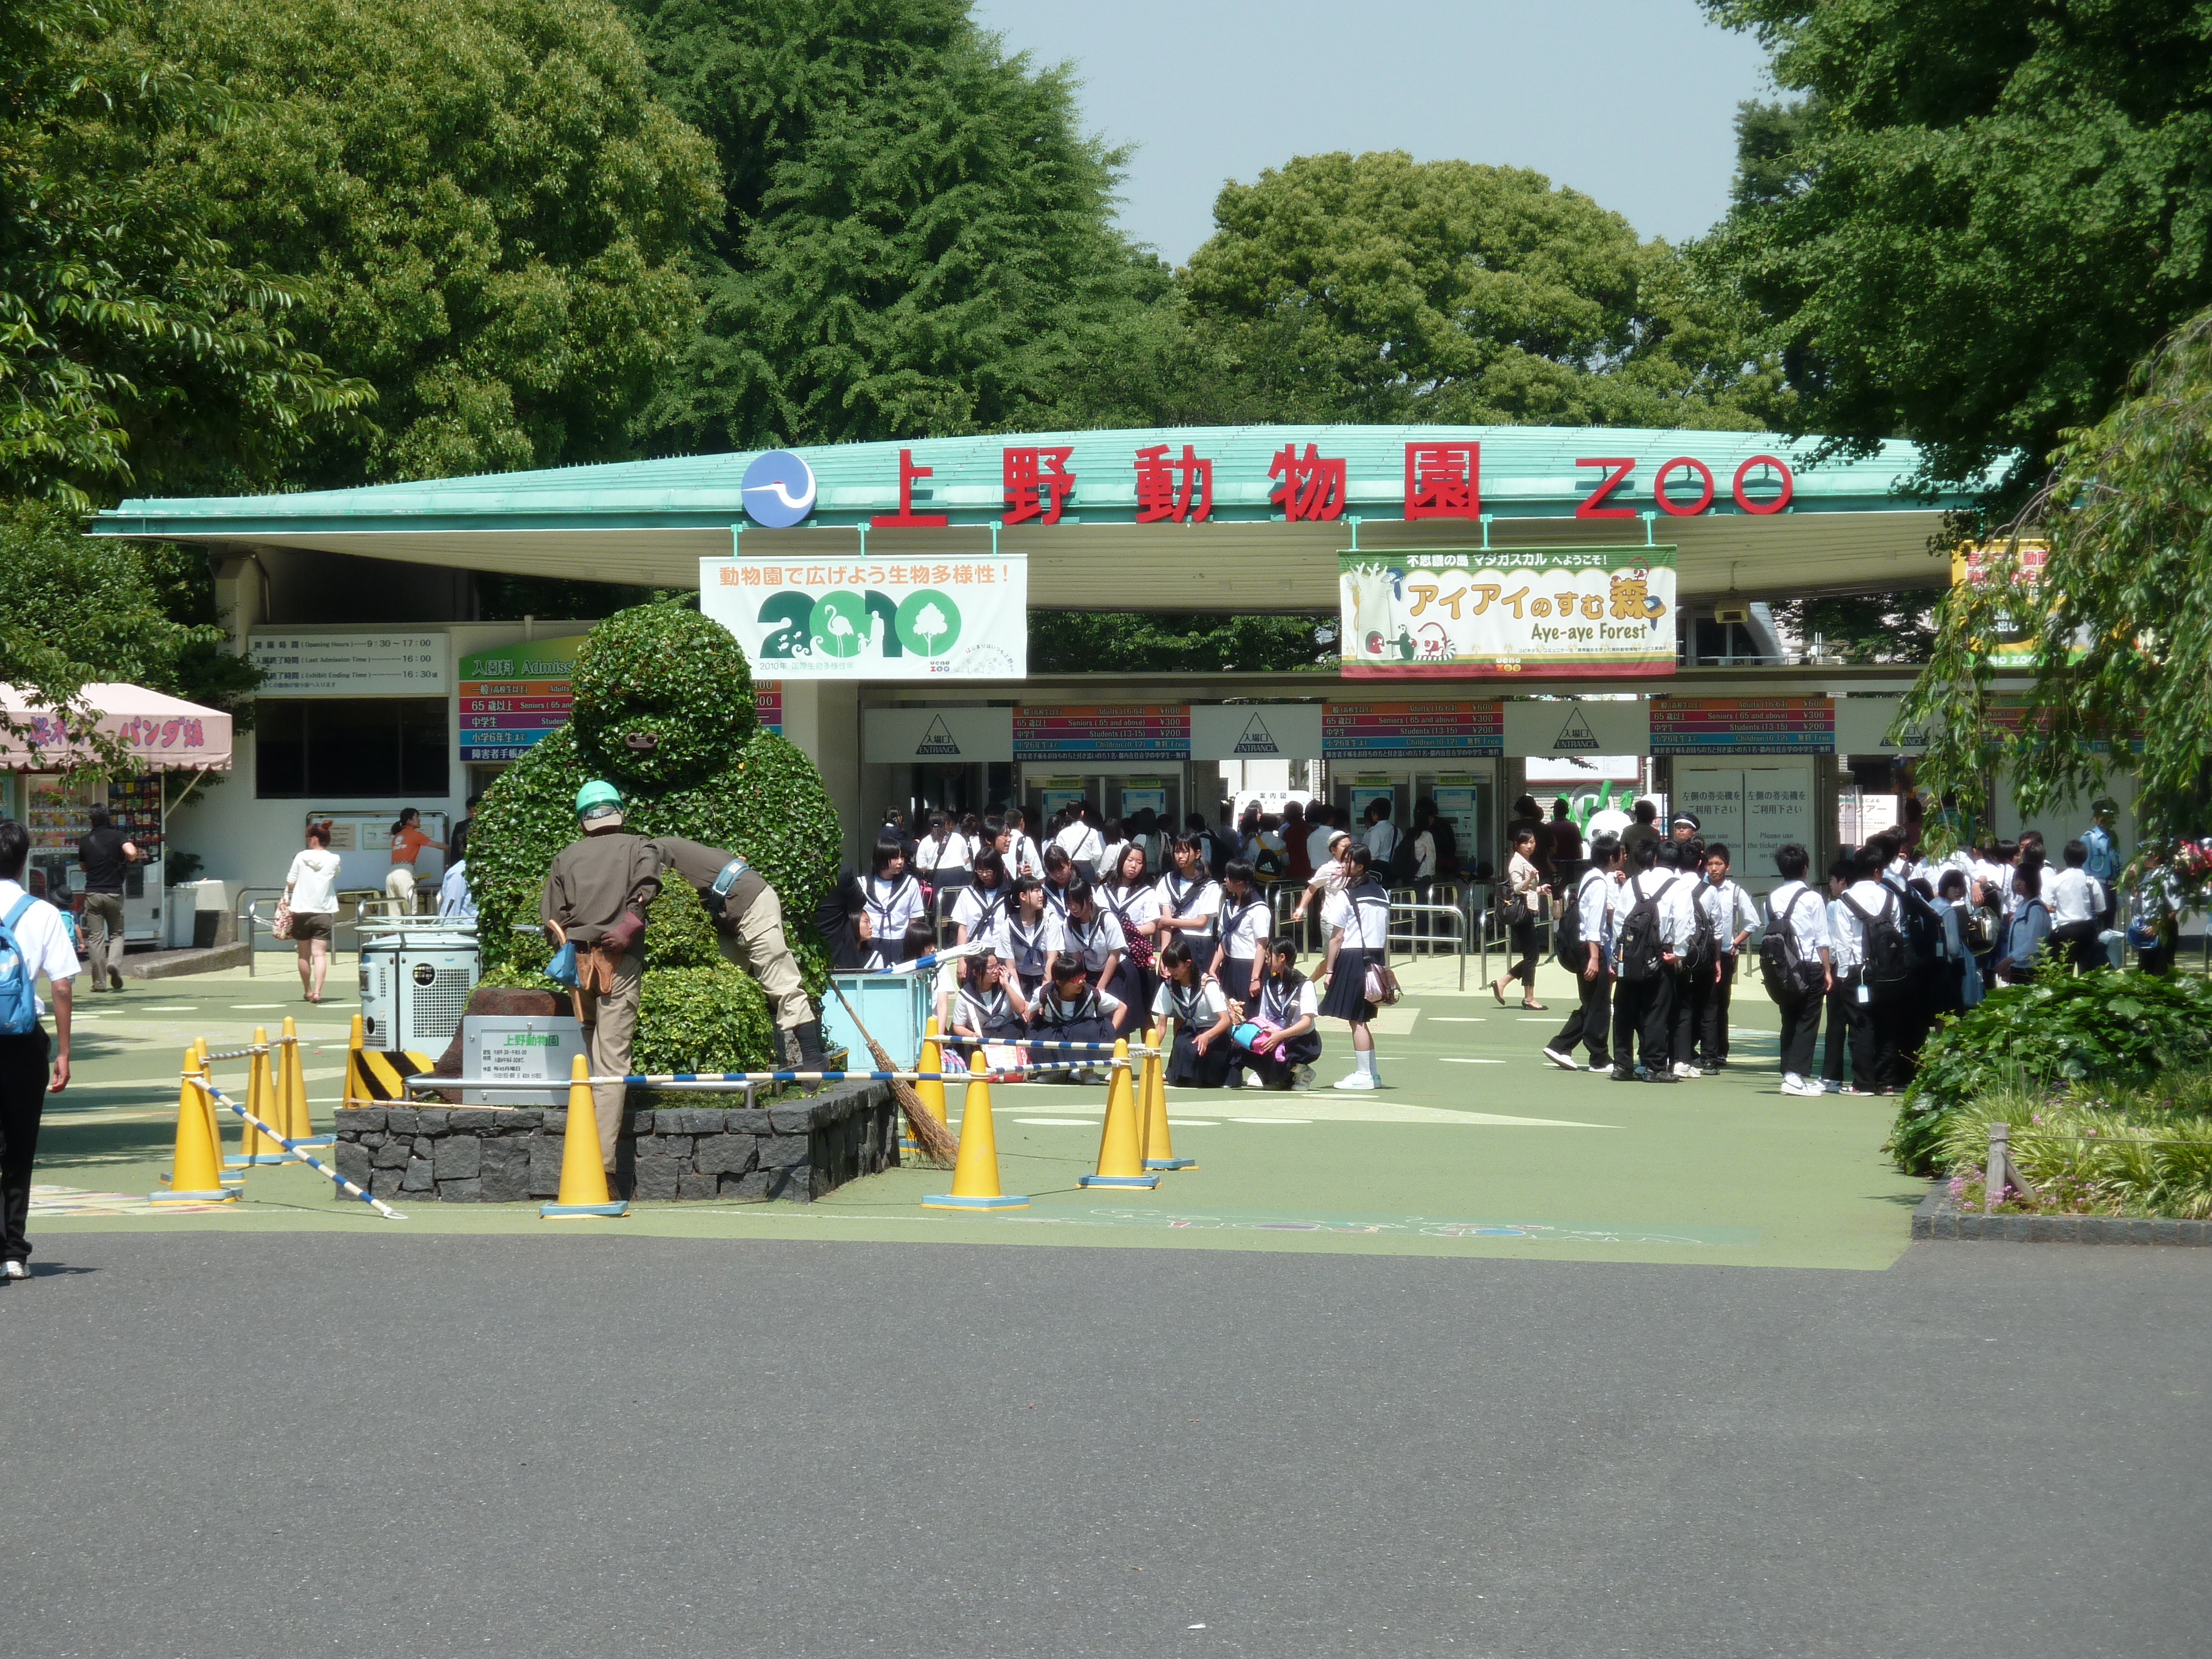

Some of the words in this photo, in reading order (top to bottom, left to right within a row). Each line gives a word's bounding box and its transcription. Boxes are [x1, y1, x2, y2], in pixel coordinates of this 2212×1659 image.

[870, 441, 1480, 527] 上野動物園
[1575, 455, 1793, 519] ZOO
[1407, 554, 1469, 567] 不思議の島
[1474, 554, 1547, 566] マダガスカル
[1408, 578, 1651, 620] アイアイのすむ森
[1531, 623, 1594, 643] Aye-aye
[1599, 623, 1648, 639] Forest
[472, 659, 515, 677] 入園料
[759, 662, 787, 670] 2010年
[1708, 712, 1734, 720] Seniors
[472, 716, 498, 728] 中学生
[119, 715, 204, 748] パンダ焼
[1326, 728, 1345, 737] 中学生
[1563, 728, 1589, 738] 入場口
[1654, 724, 1674, 732] 中学生
[925, 734, 950, 744] 入場口
[1017, 730, 1036, 739] 中学生
[1243, 733, 1268, 742] 入場口
[1682, 790, 1741, 801] 左側の券売機を
[1747, 790, 1806, 801] 左側の券売機を
[1688, 804, 1738, 815] ご利用下さい
[1752, 804, 1802, 815] ご利用下さい
[503, 1034, 560, 1047] 上野動物園
